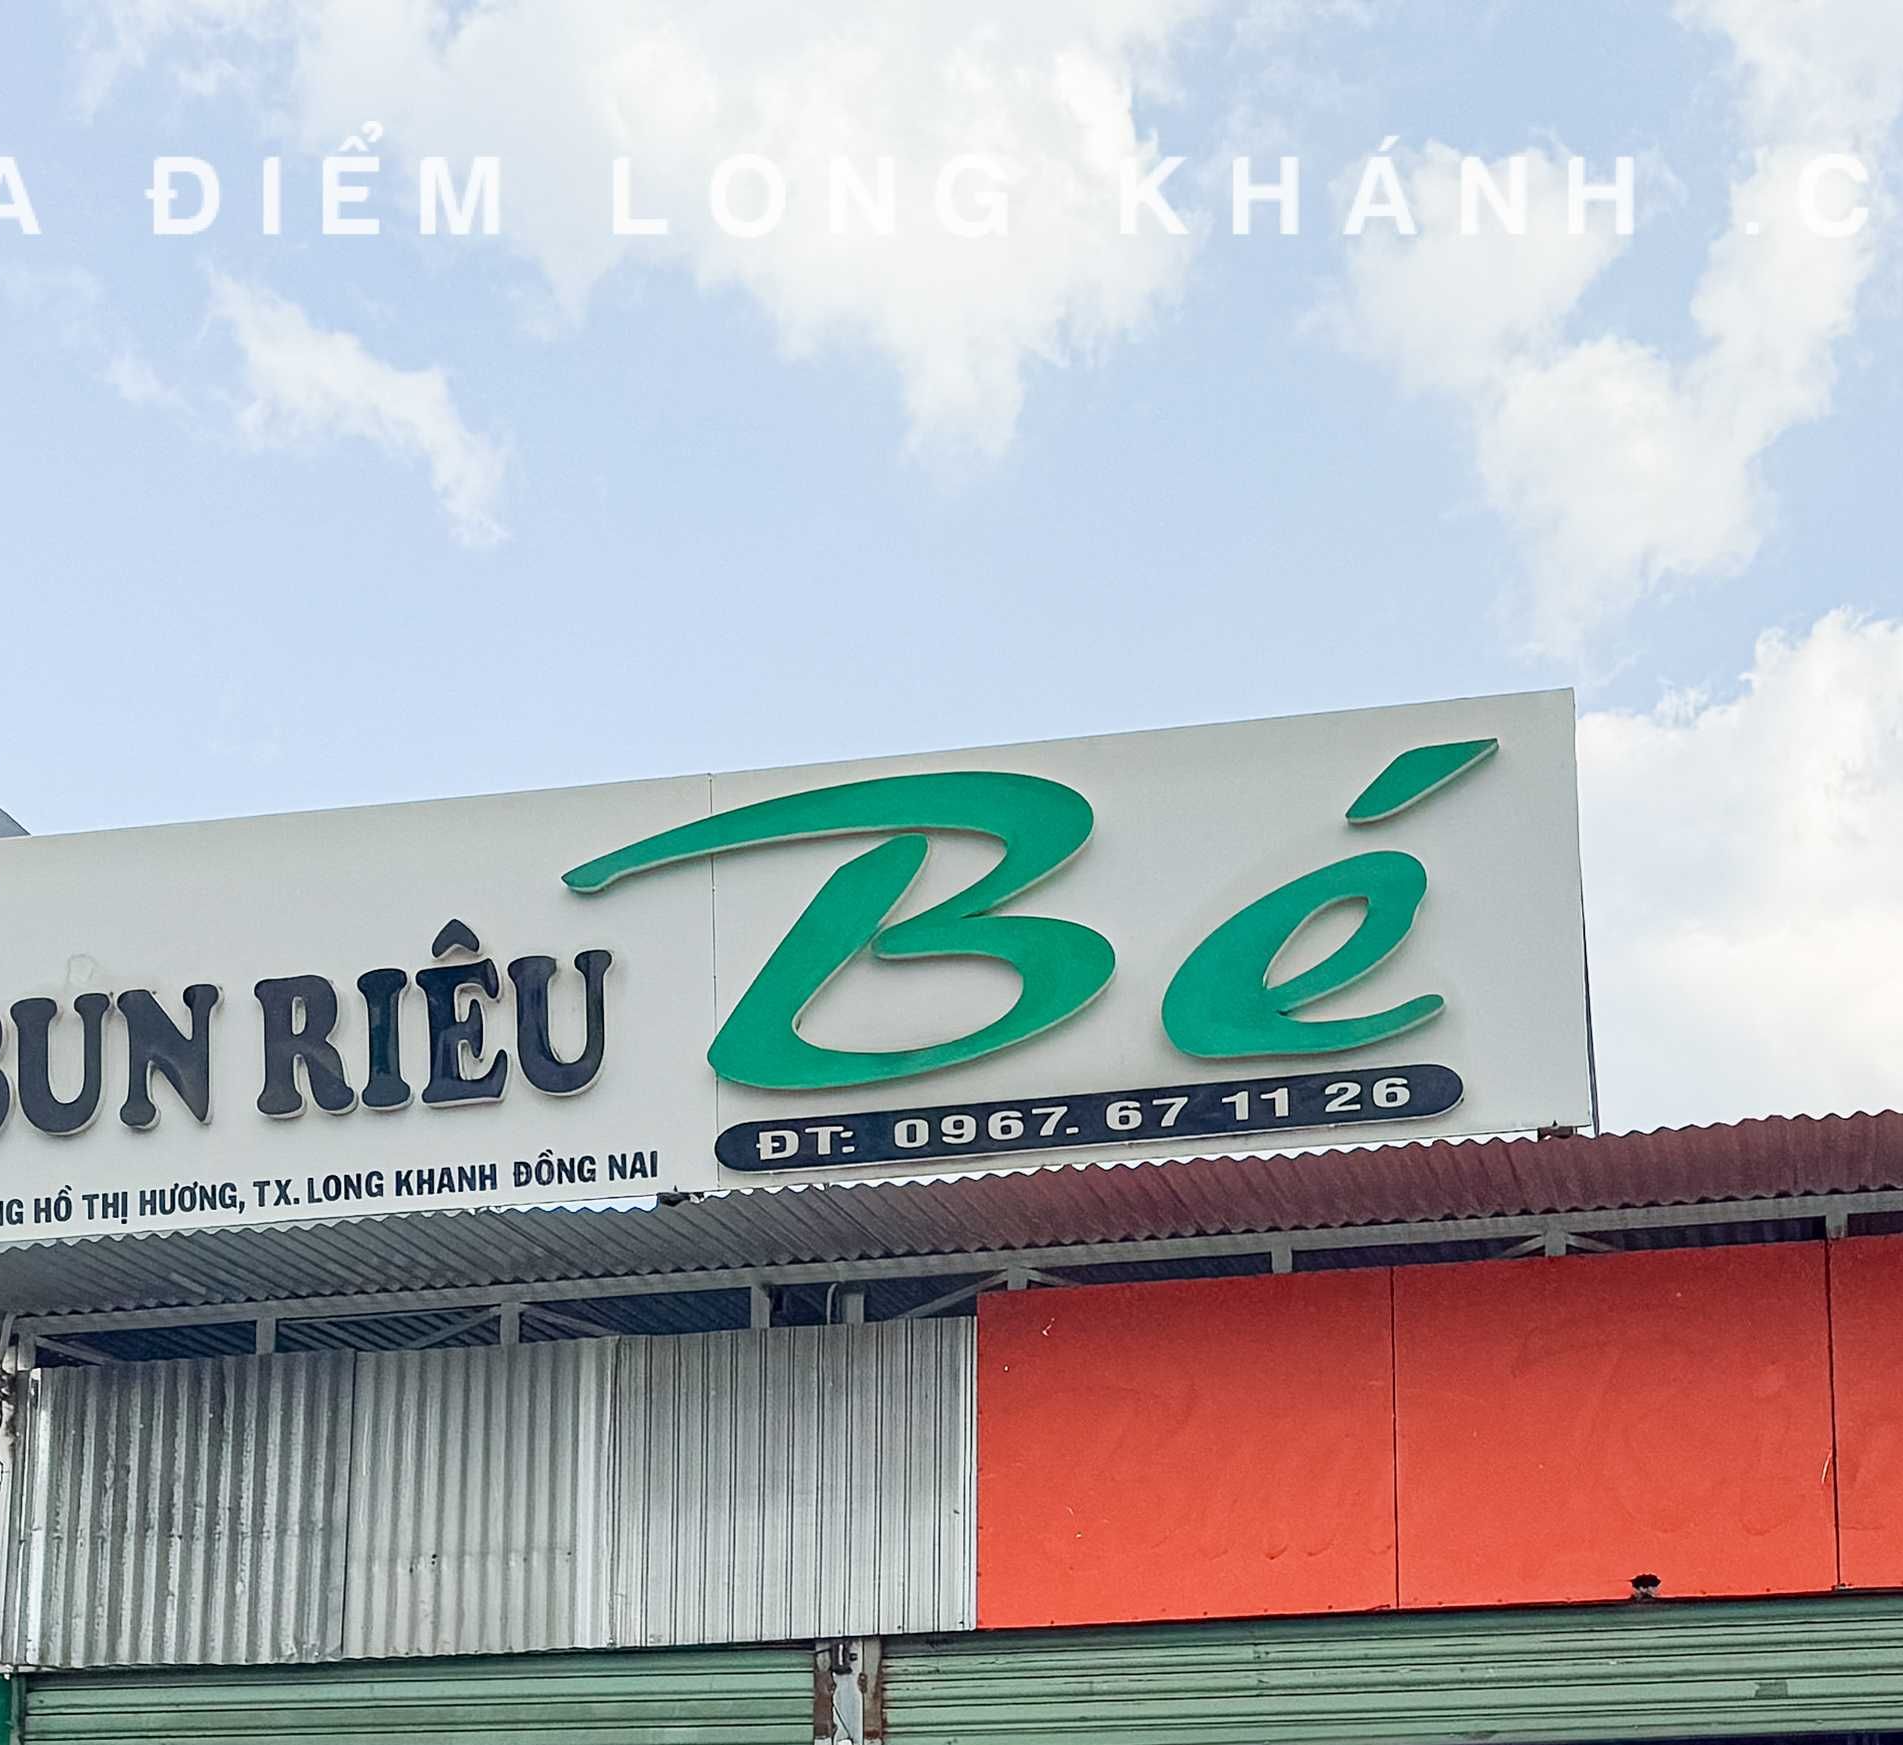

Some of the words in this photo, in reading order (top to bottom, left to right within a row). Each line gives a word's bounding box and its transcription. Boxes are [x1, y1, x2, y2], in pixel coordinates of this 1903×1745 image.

[561, 738, 1498, 1092] Bé
[252, 918, 616, 1118] RIÊU
[33, 1184, 73, 1224] HỒ
[81, 1190, 129, 1225] THỊ
[138, 1180, 246, 1217] HƯƠNG,
[252, 1178, 300, 1208] TX.
[307, 1170, 385, 1204] LONG
[395, 1163, 498, 1197] KHANH
[512, 1148, 597, 1188] ĐỒNG
[607, 1150, 659, 1182] NAI
[756, 1124, 855, 1162] ĐT:
[892, 1104, 1081, 1150] 0967.
[1105, 1095, 1191, 1132] 67
[1220, 1086, 1292, 1123] 11
[1323, 1075, 1413, 1114] 26
